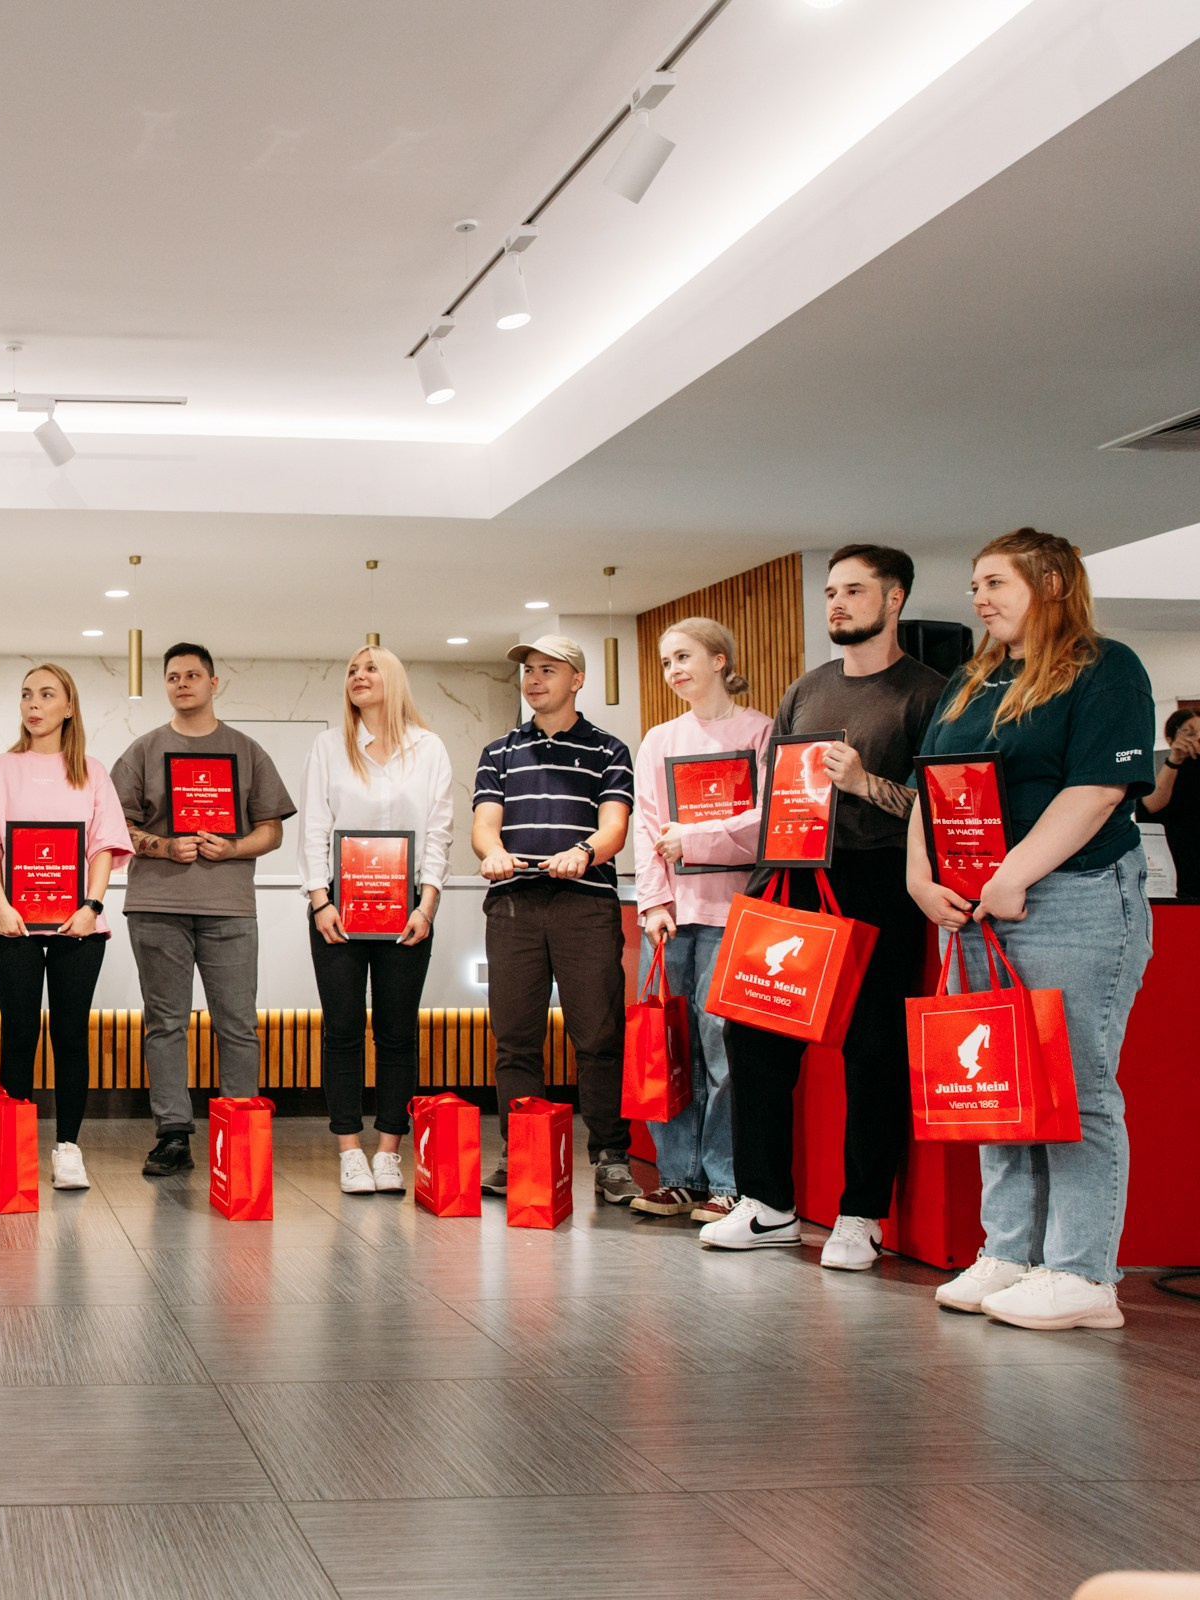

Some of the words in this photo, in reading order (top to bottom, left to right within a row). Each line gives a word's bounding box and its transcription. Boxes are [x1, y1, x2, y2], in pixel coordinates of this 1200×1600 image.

[1116, 749, 1142, 757] COFFEE
[735, 971, 771, 987] Julius
[774, 980, 807, 996] Meinl
[745, 988, 771, 1002] Vienna
[772, 996, 791, 1007] 1862
[935, 1083, 972, 1094] Julius
[976, 1081, 1009, 1092] Meinl
[949, 1101, 978, 1109] Vienna
[978, 1100, 999, 1109] 1862
